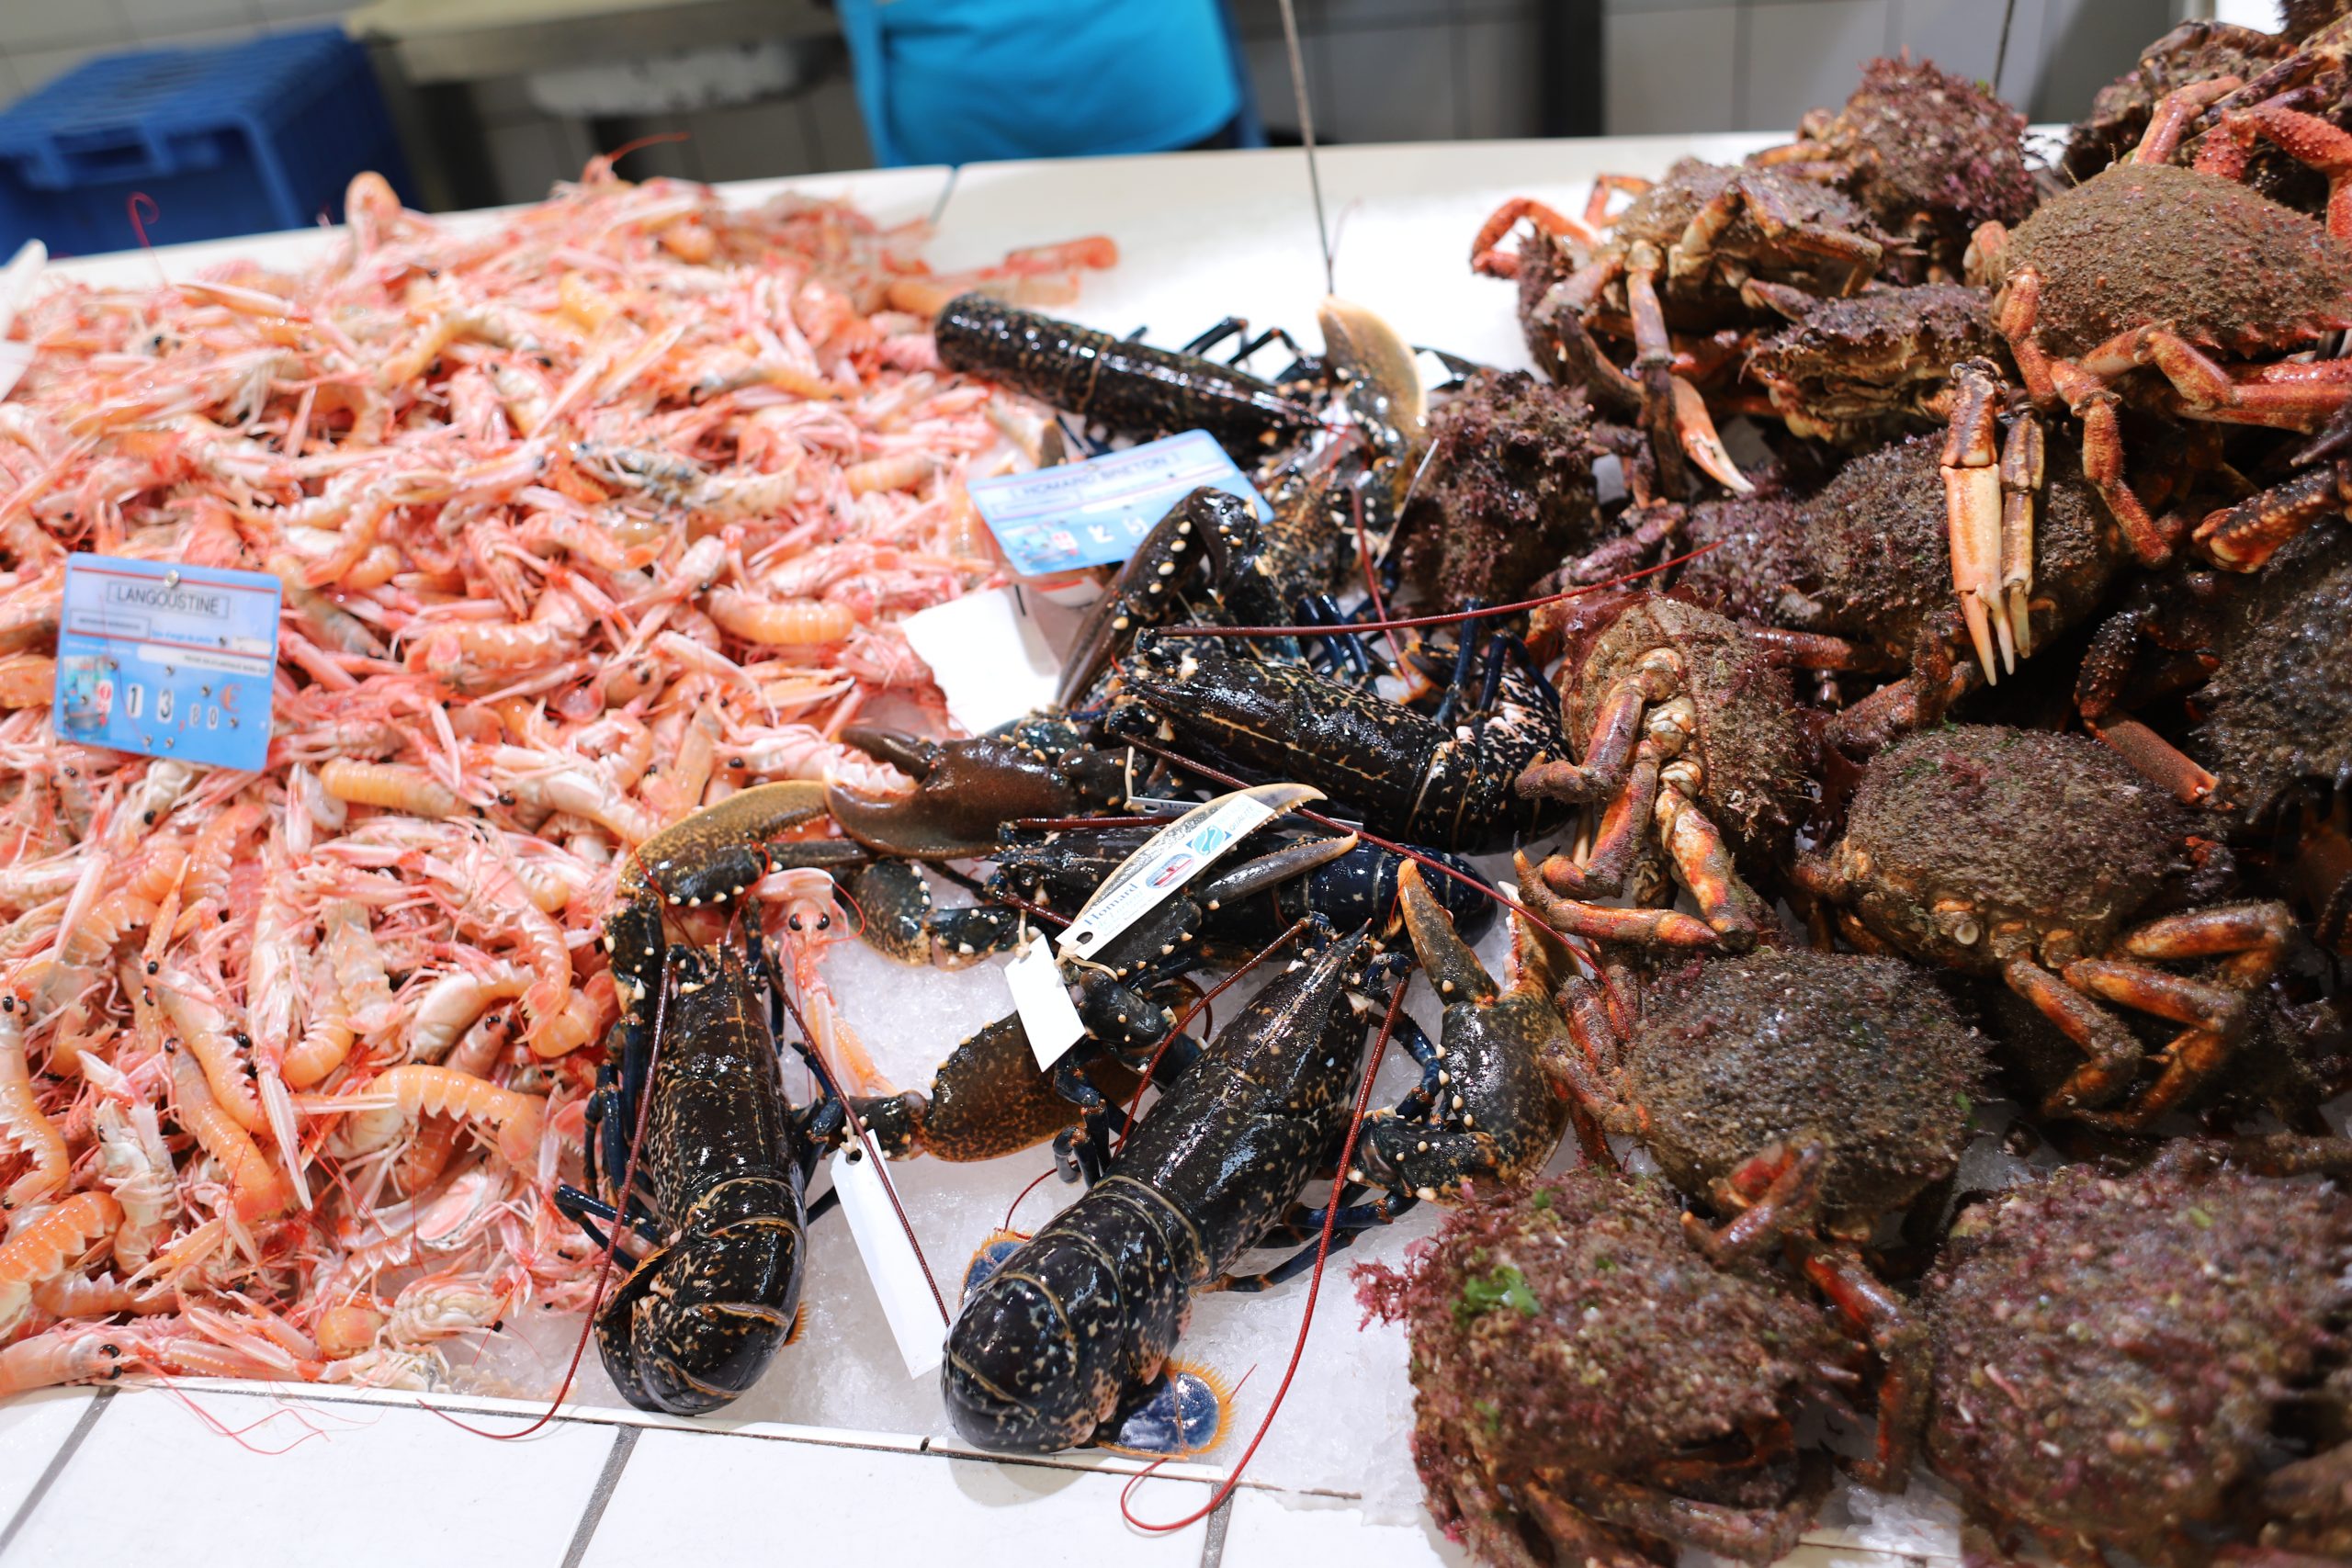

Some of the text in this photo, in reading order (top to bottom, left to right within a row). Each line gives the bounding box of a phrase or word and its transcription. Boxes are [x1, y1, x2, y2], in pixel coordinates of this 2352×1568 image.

[1022, 475, 1094, 495] HOMARD
[117, 586, 219, 615] LANGOUSTINE
[1160, 802, 1197, 810] Hom
[1084, 883, 1139, 926] Homard
